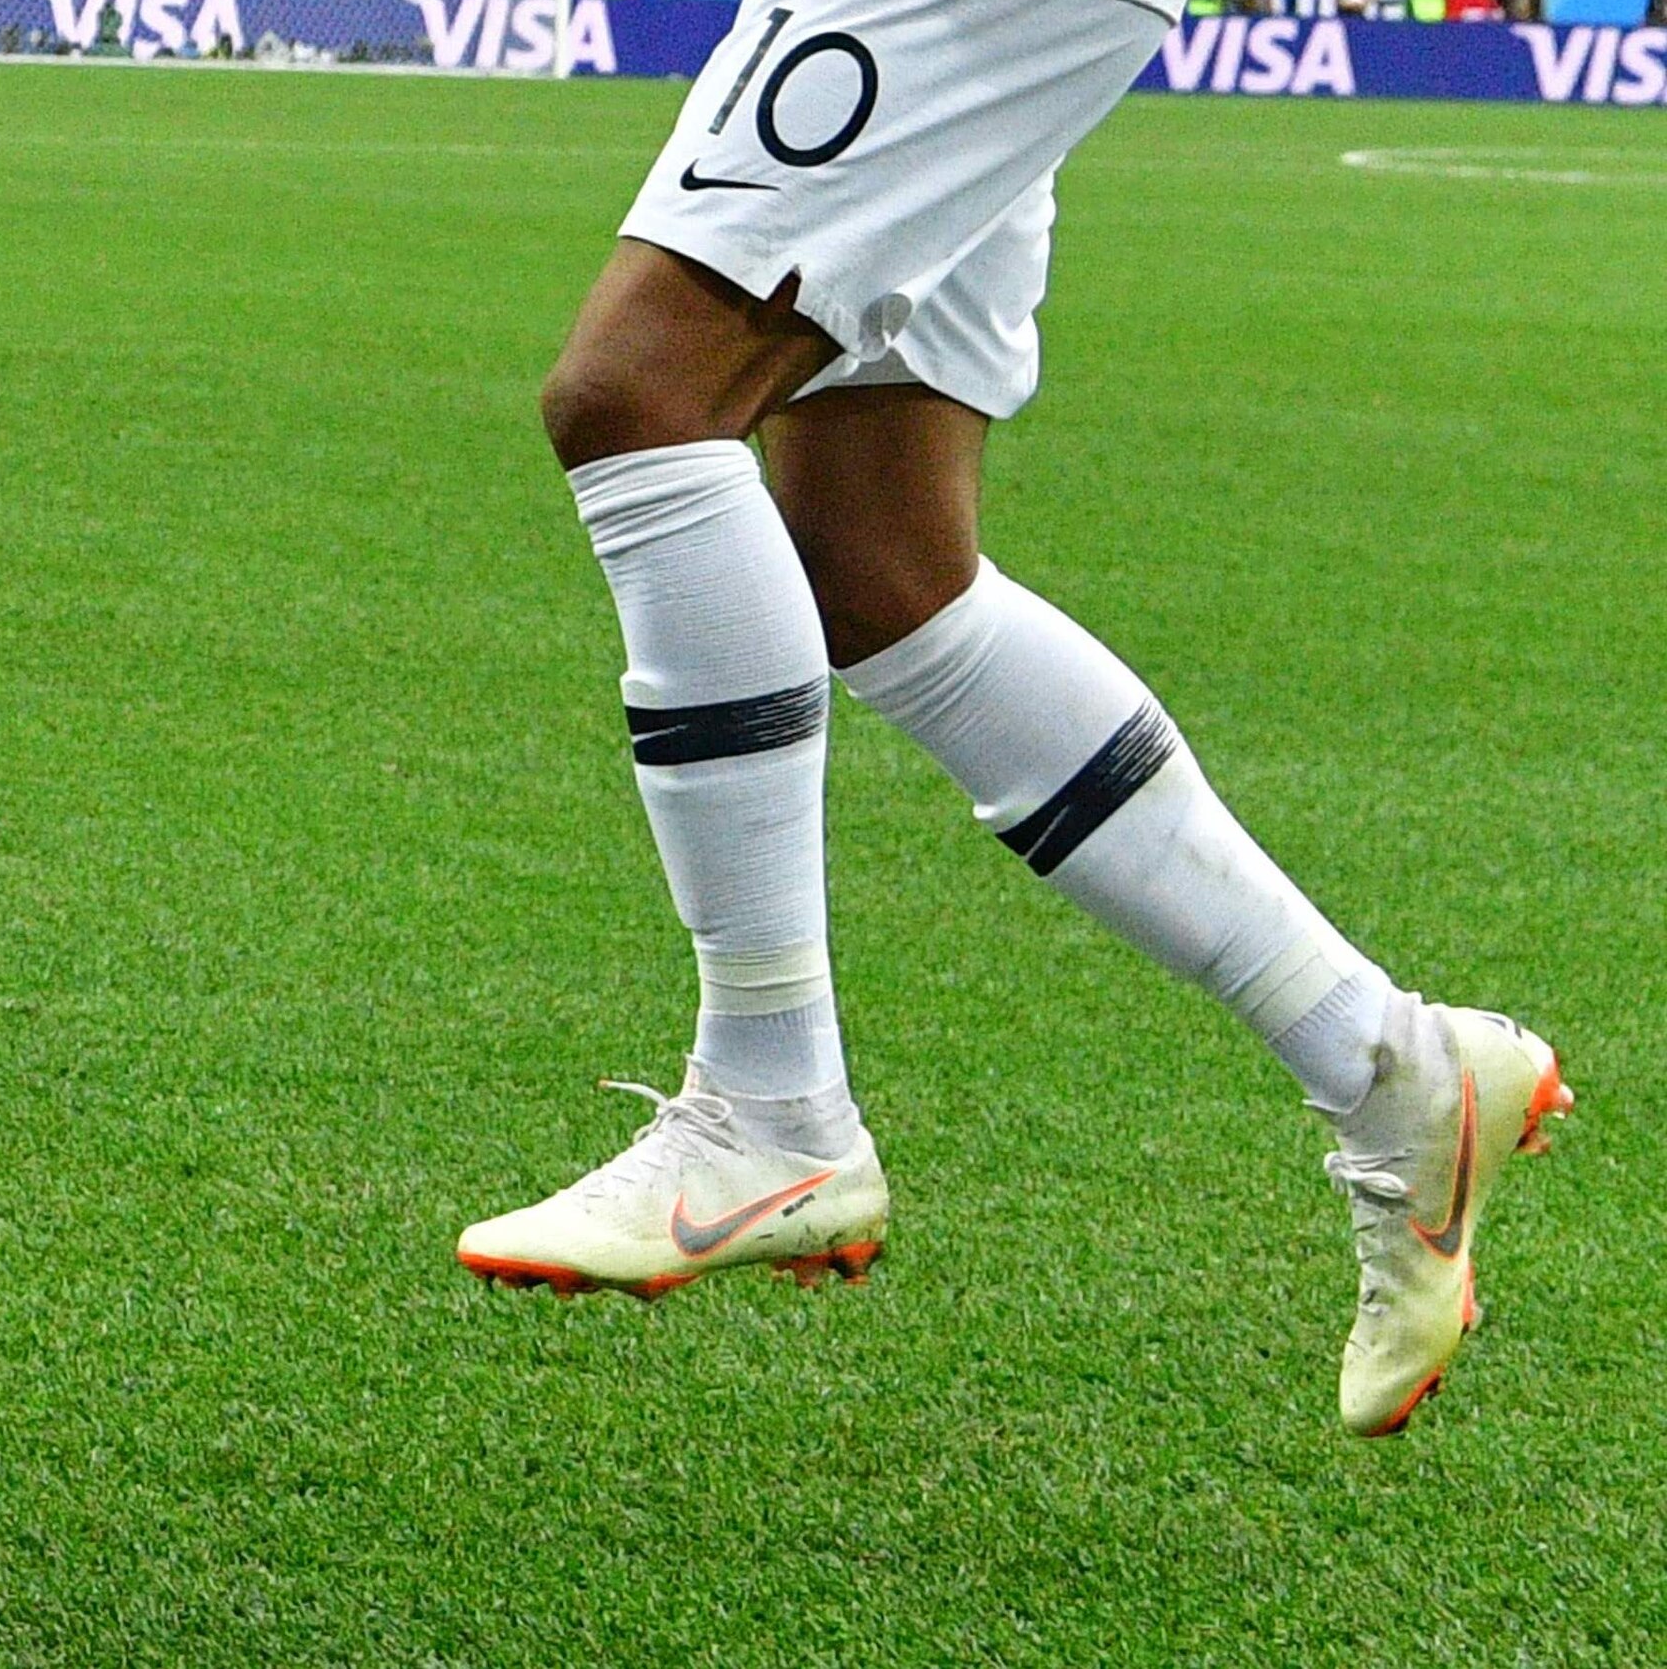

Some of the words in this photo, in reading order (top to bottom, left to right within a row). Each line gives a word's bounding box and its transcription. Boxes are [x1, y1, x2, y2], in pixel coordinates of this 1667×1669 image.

[708, 7, 878, 168] 10
[1163, 16, 1356, 95] VISA
[1510, 26, 1667, 105] VIS
